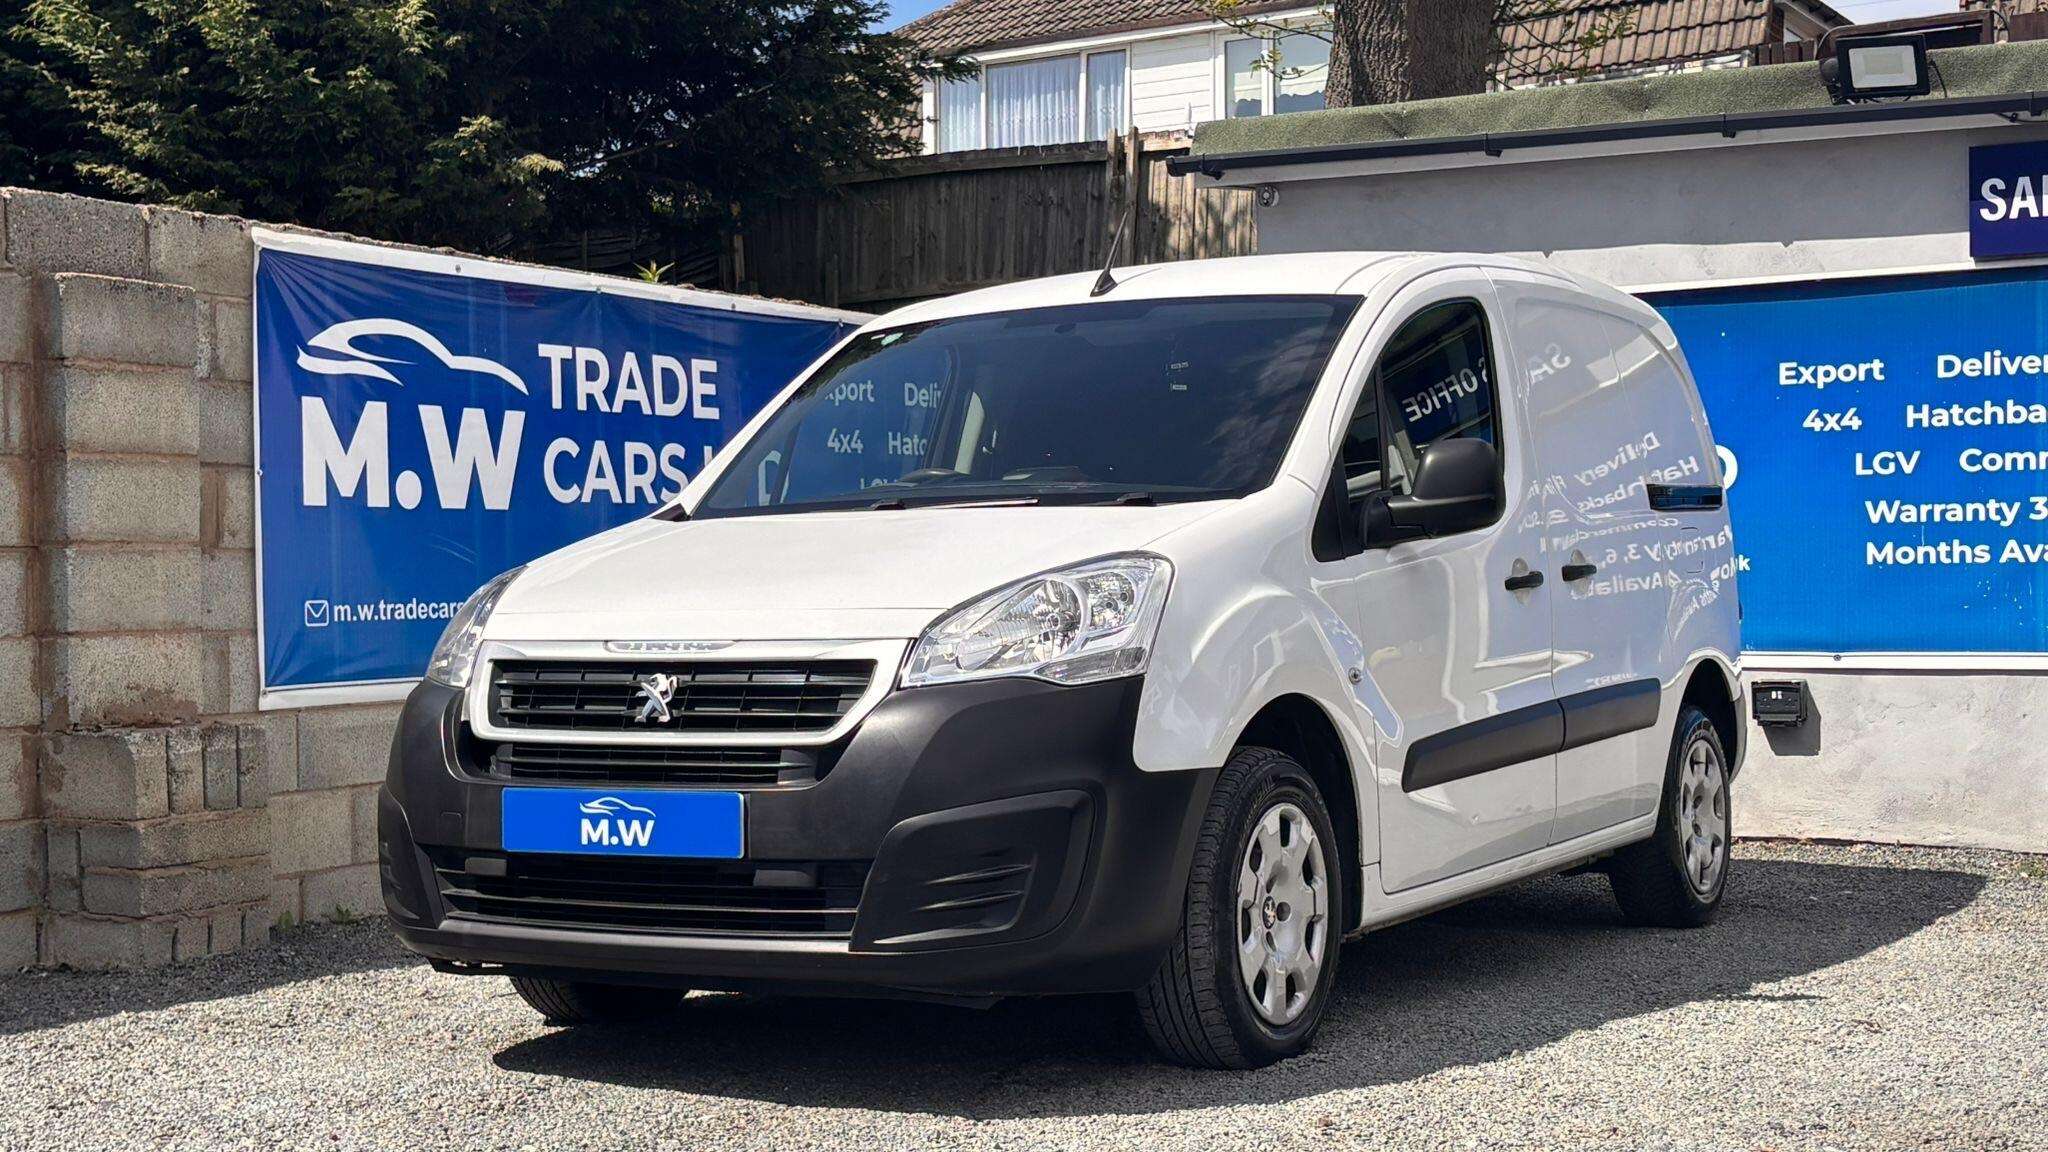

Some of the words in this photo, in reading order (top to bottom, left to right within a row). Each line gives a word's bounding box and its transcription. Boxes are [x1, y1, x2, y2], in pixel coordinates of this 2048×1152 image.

[1979, 174, 2048, 221] SA
[538, 344, 720, 420] TRADE
[1779, 358, 1885, 389] Export
[824, 379, 875, 406] port
[1802, 407, 1862, 432] 4x4
[1906, 399, 2048, 428] Hatchba
[301, 395, 526, 511] M.W
[827, 427, 864, 454] 4x4
[543, 436, 690, 504] CARS
[1855, 450, 1921, 476] LGV
[1865, 500, 2021, 527] Warranty
[1866, 539, 1991, 566] Months
[581, 818, 655, 846] M.W
